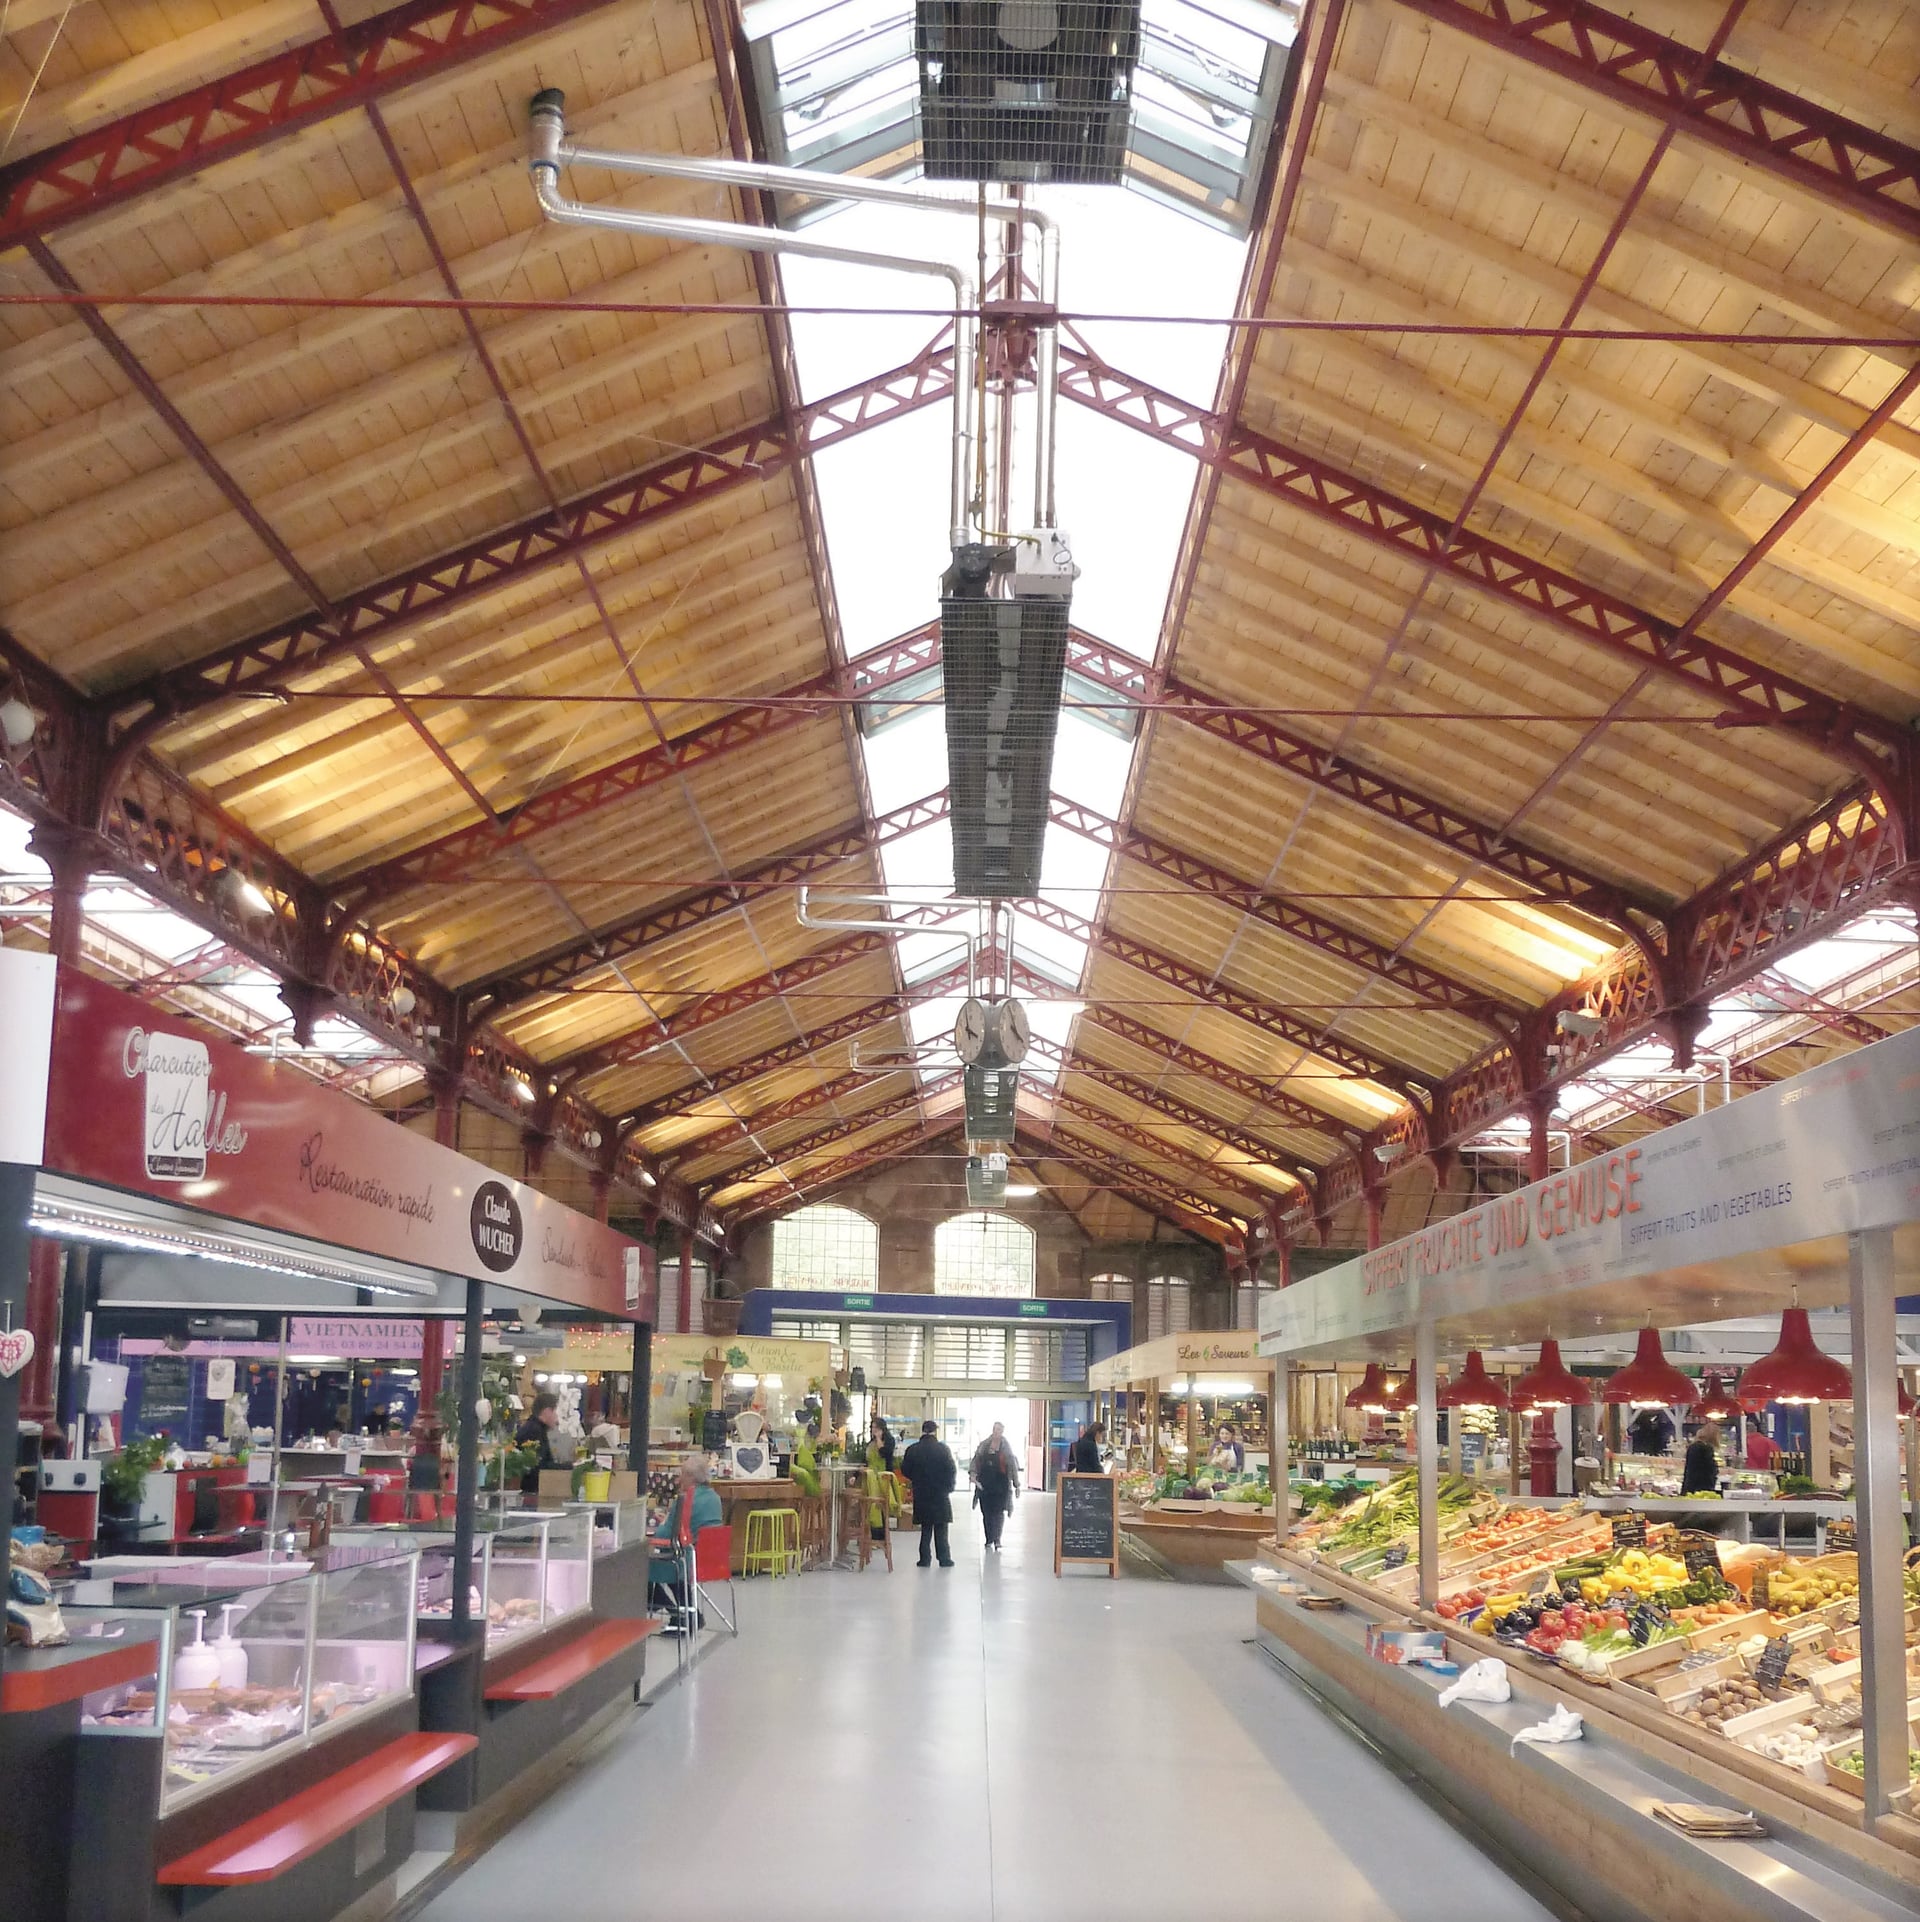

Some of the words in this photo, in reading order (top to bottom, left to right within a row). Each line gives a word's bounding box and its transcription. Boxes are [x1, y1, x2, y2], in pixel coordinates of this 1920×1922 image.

[152, 1078, 248, 1155] Halles
[299, 1131, 395, 1209] Restauration
[398, 1183, 434, 1235] rapide
[484, 1194, 512, 1226] Claude
[1630, 1220, 1663, 1245] SIFFERT
[1665, 1210, 1696, 1234] FRUITS
[1699, 1203, 1720, 1225] AND
[1723, 1182, 1792, 1220] VEGETABLES
[478, 1223, 515, 1257] WUCHER
[1363, 1243, 1410, 1296] SIFFERT
[1487, 1195, 1529, 1256] UND
[846, 1297, 871, 1307] SORTIE
[1022, 1304, 1045, 1313] SORTIE
[304, 1323, 424, 1338] VIETNAMIEN
[748, 1342, 781, 1356] Citron
[1178, 1345, 1200, 1360] Les
[1210, 1345, 1250, 1360] Saveurs
